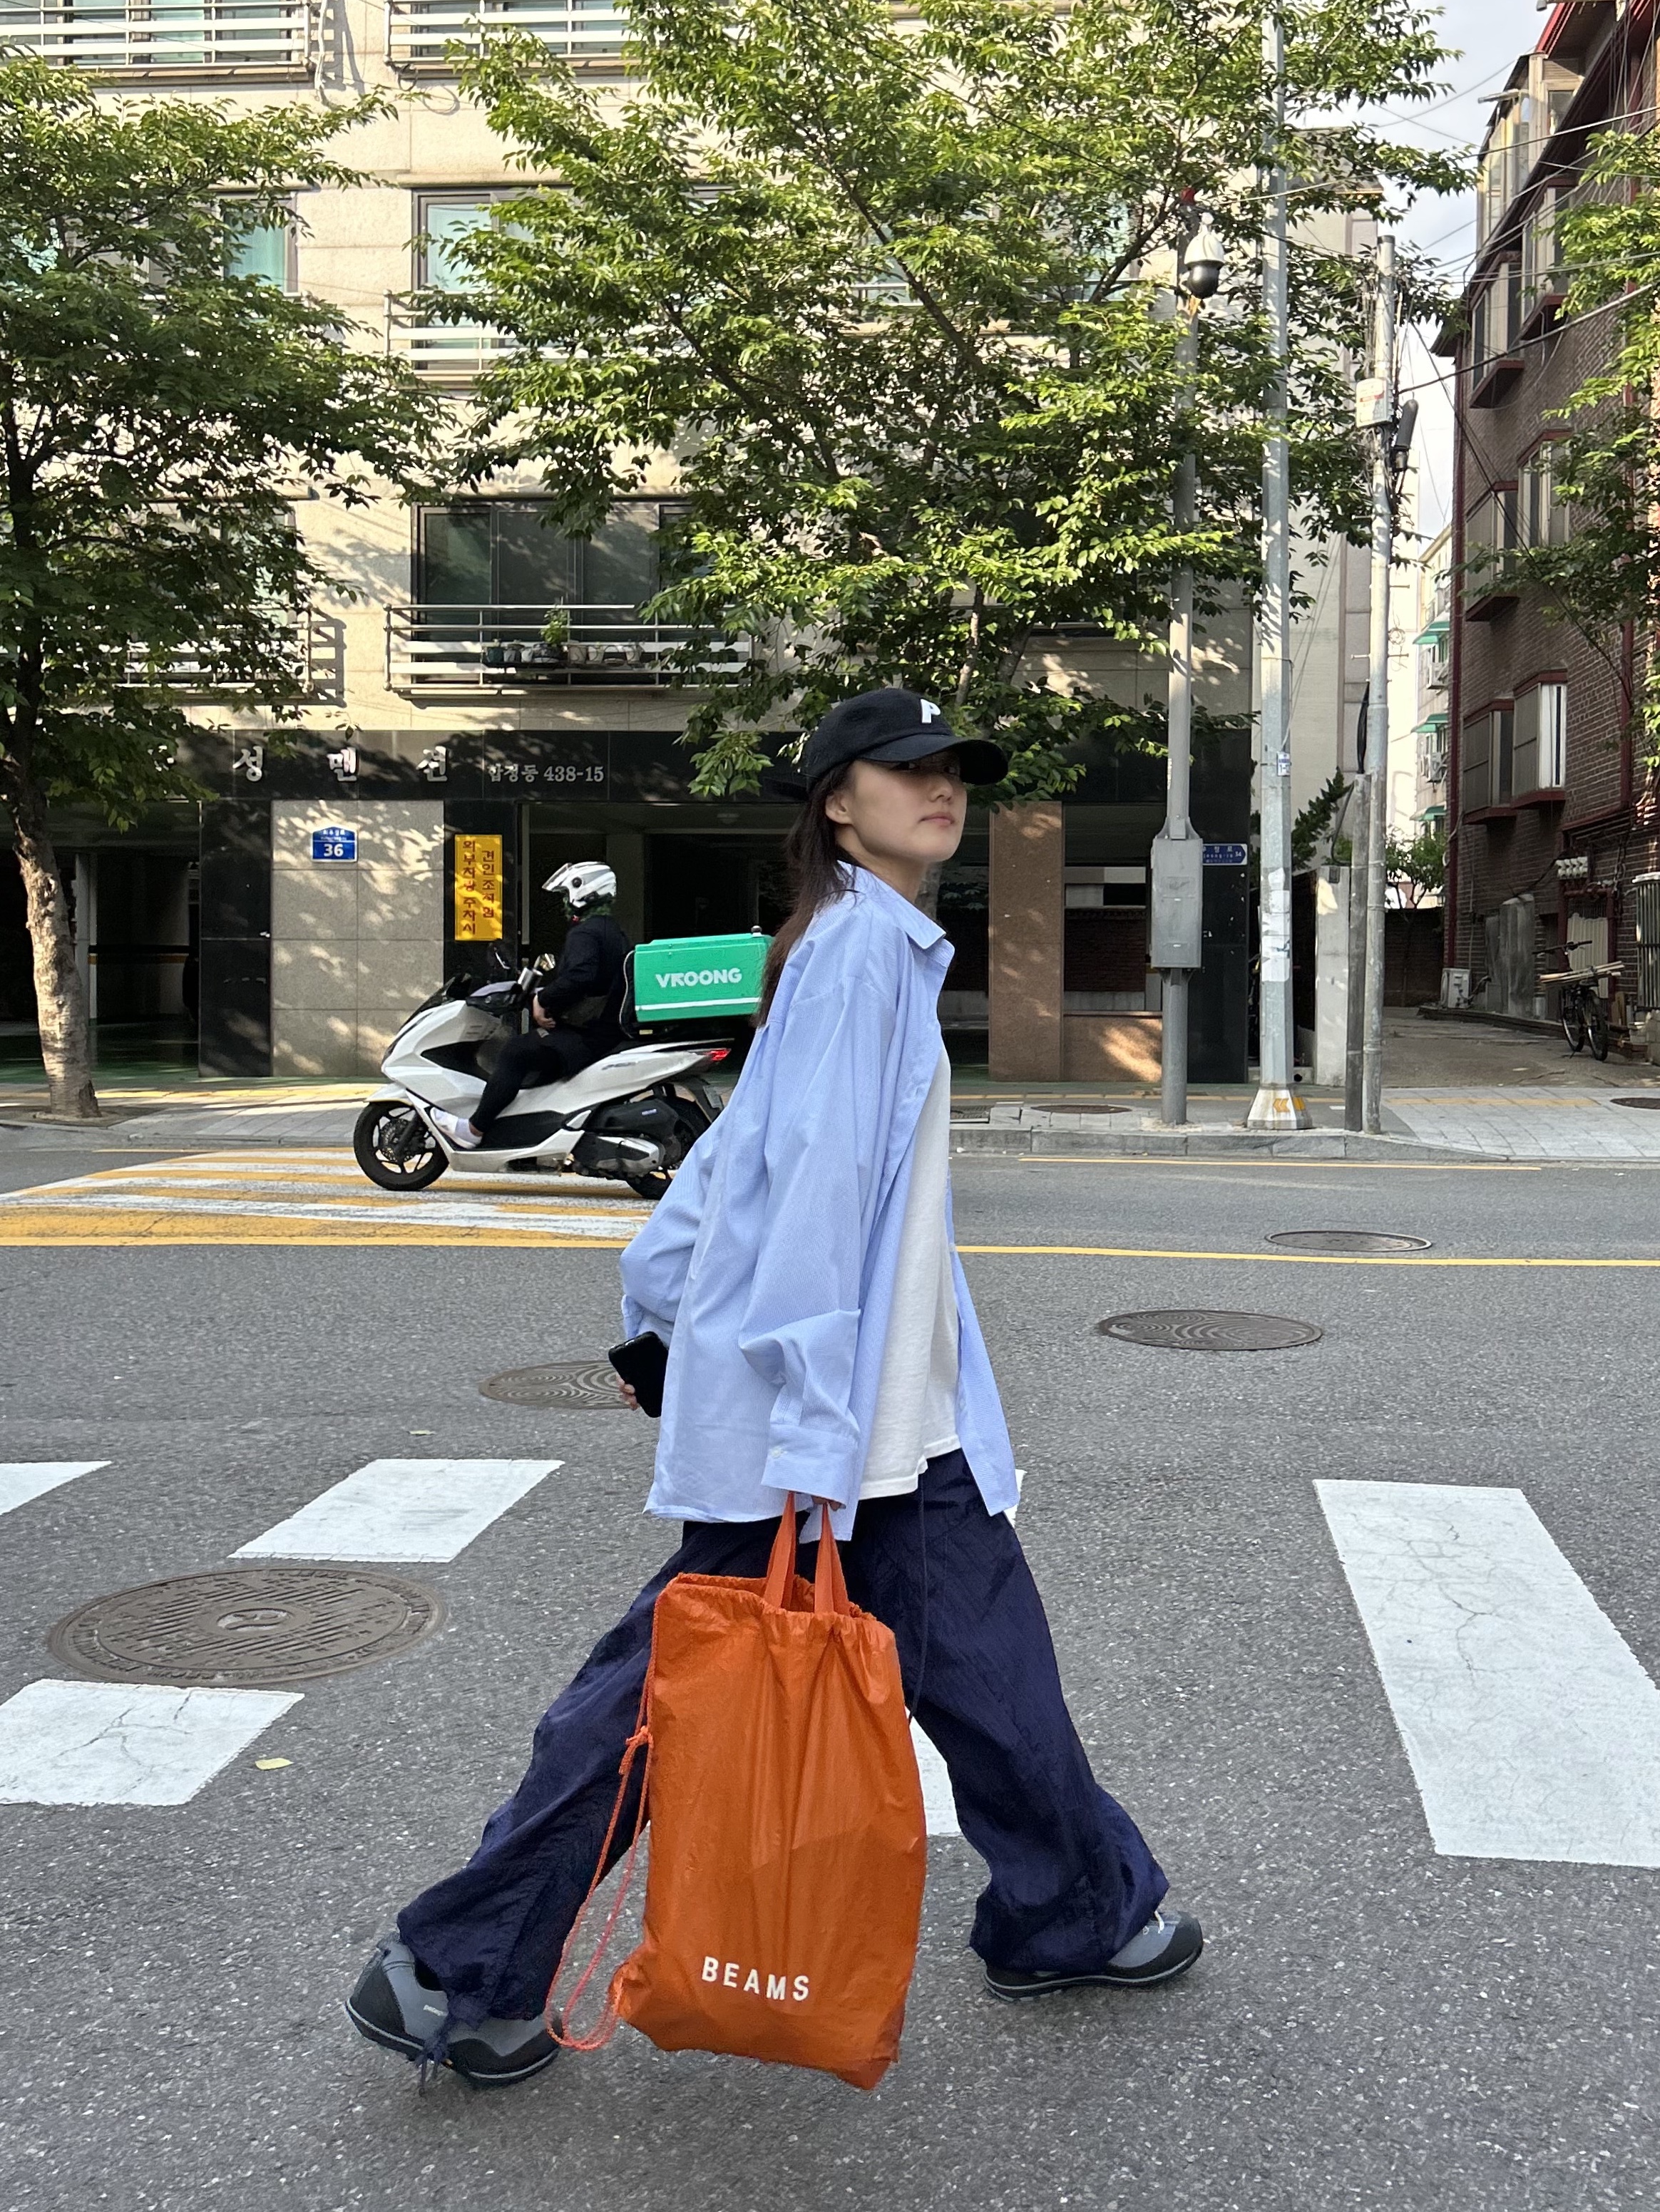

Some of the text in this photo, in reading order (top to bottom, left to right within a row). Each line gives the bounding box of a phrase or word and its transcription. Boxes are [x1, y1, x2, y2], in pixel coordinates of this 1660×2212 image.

[487, 763, 605, 783] 합정동 438-15
[323, 843, 344, 857] 36
[655, 967, 742, 988] VROONG
[701, 1955, 810, 2002] BEAMS
